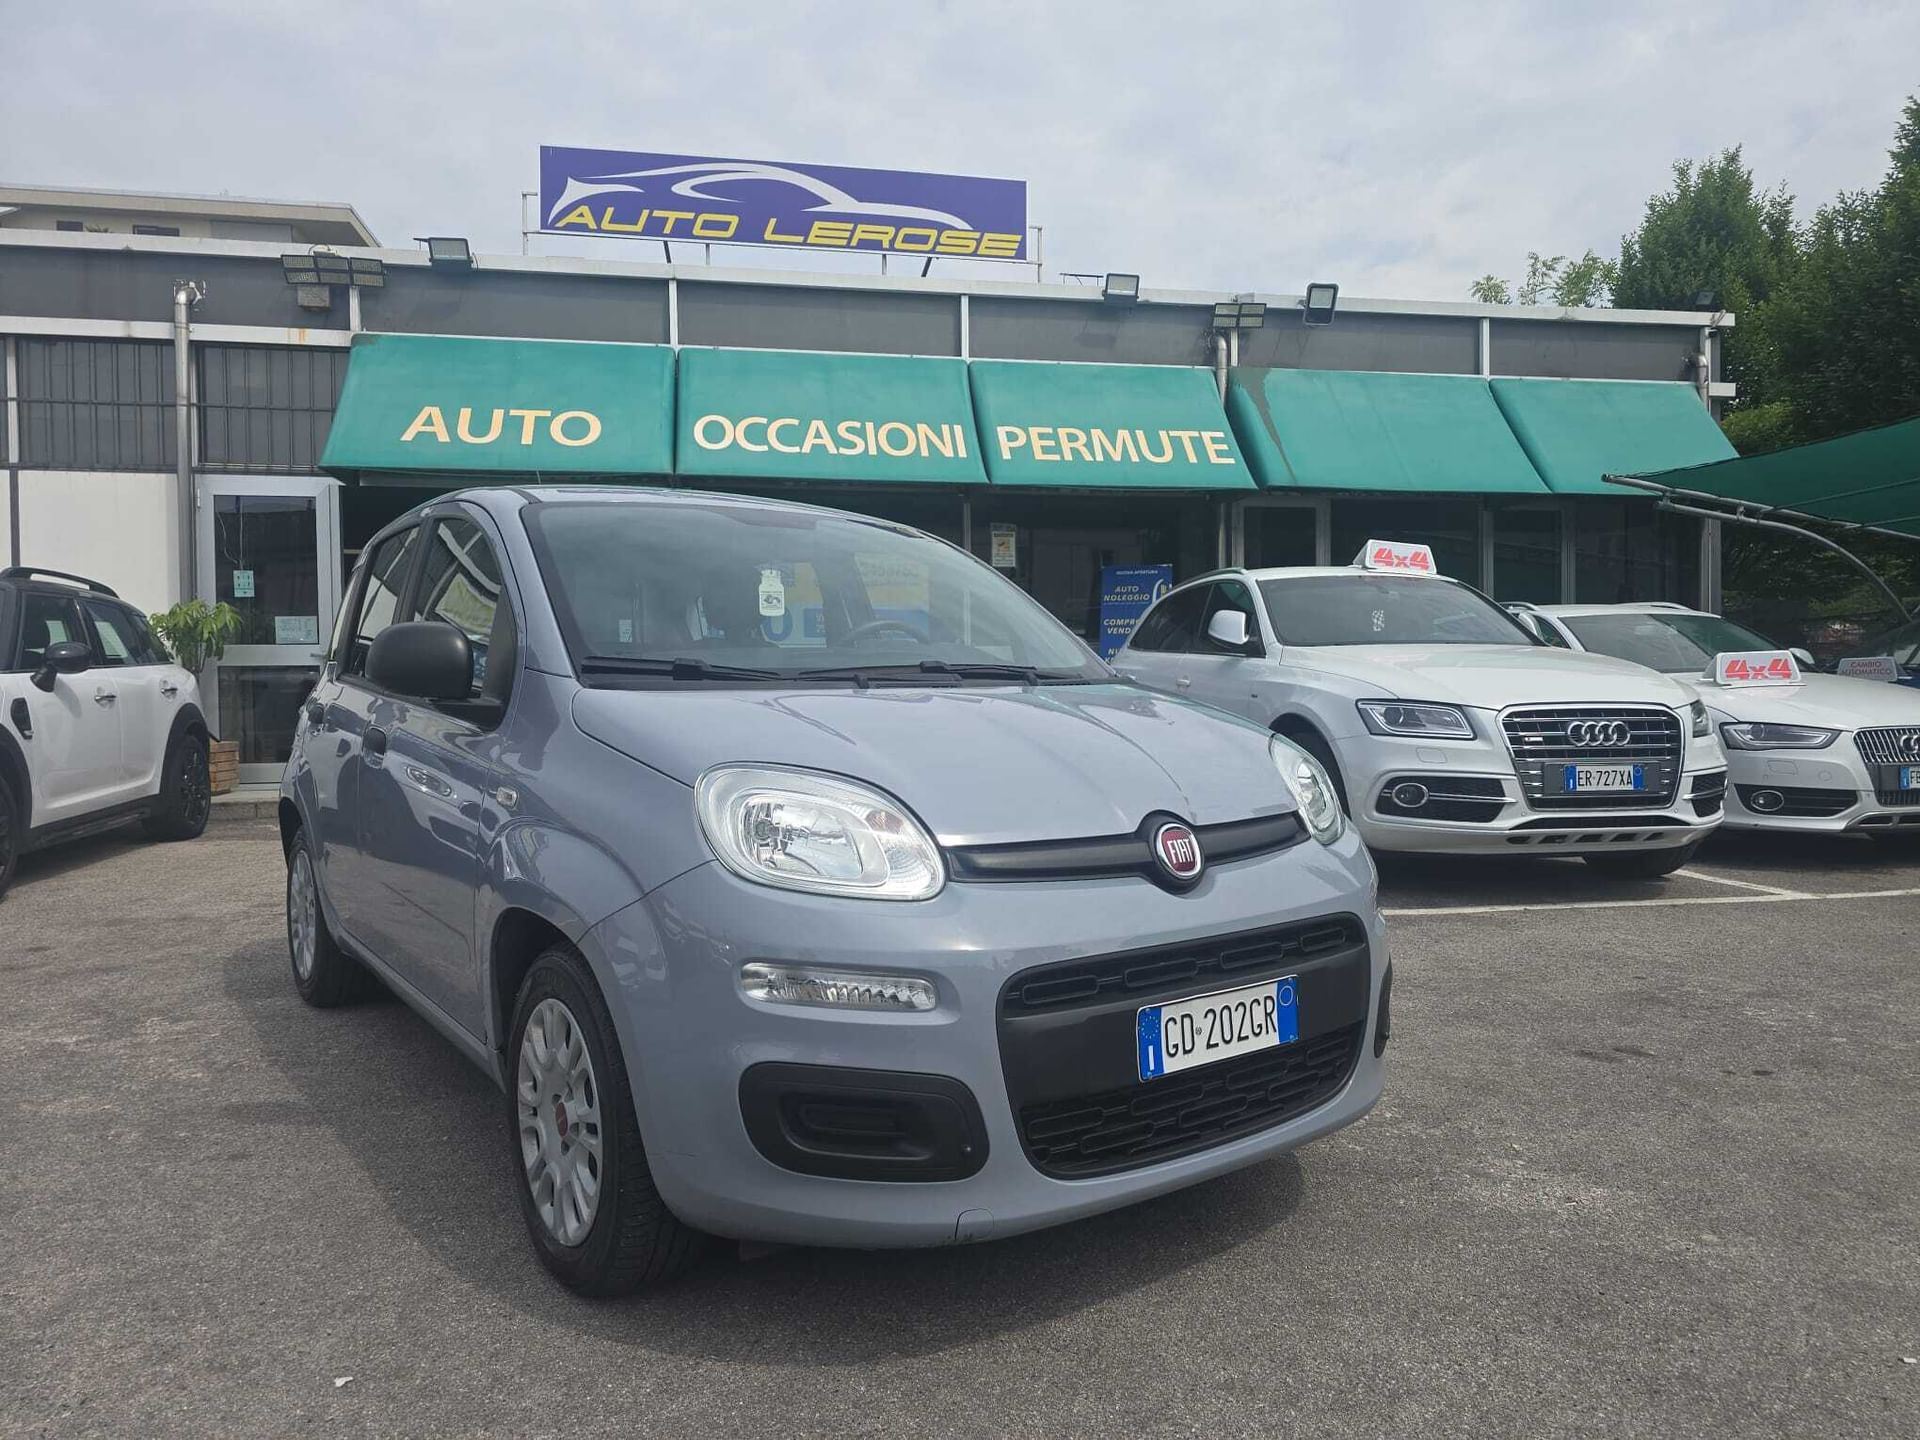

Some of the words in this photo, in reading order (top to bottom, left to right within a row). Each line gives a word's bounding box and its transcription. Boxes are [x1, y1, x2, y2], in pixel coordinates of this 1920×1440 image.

[555, 205, 741, 239] AUTO
[764, 218, 1023, 257] LEROSE
[400, 406, 602, 446] AUTO
[693, 414, 968, 458] OCCASIONI
[996, 426, 1236, 465] PERMUTE
[1374, 547, 1430, 571] 4x4
[1103, 594, 1150, 602] NOLEGGIO
[1114, 585, 1139, 593] AUTO
[1725, 657, 1792, 680] 4x4
[1850, 660, 1882, 668] CAMBIO
[1166, 838, 1194, 864] FIAT
